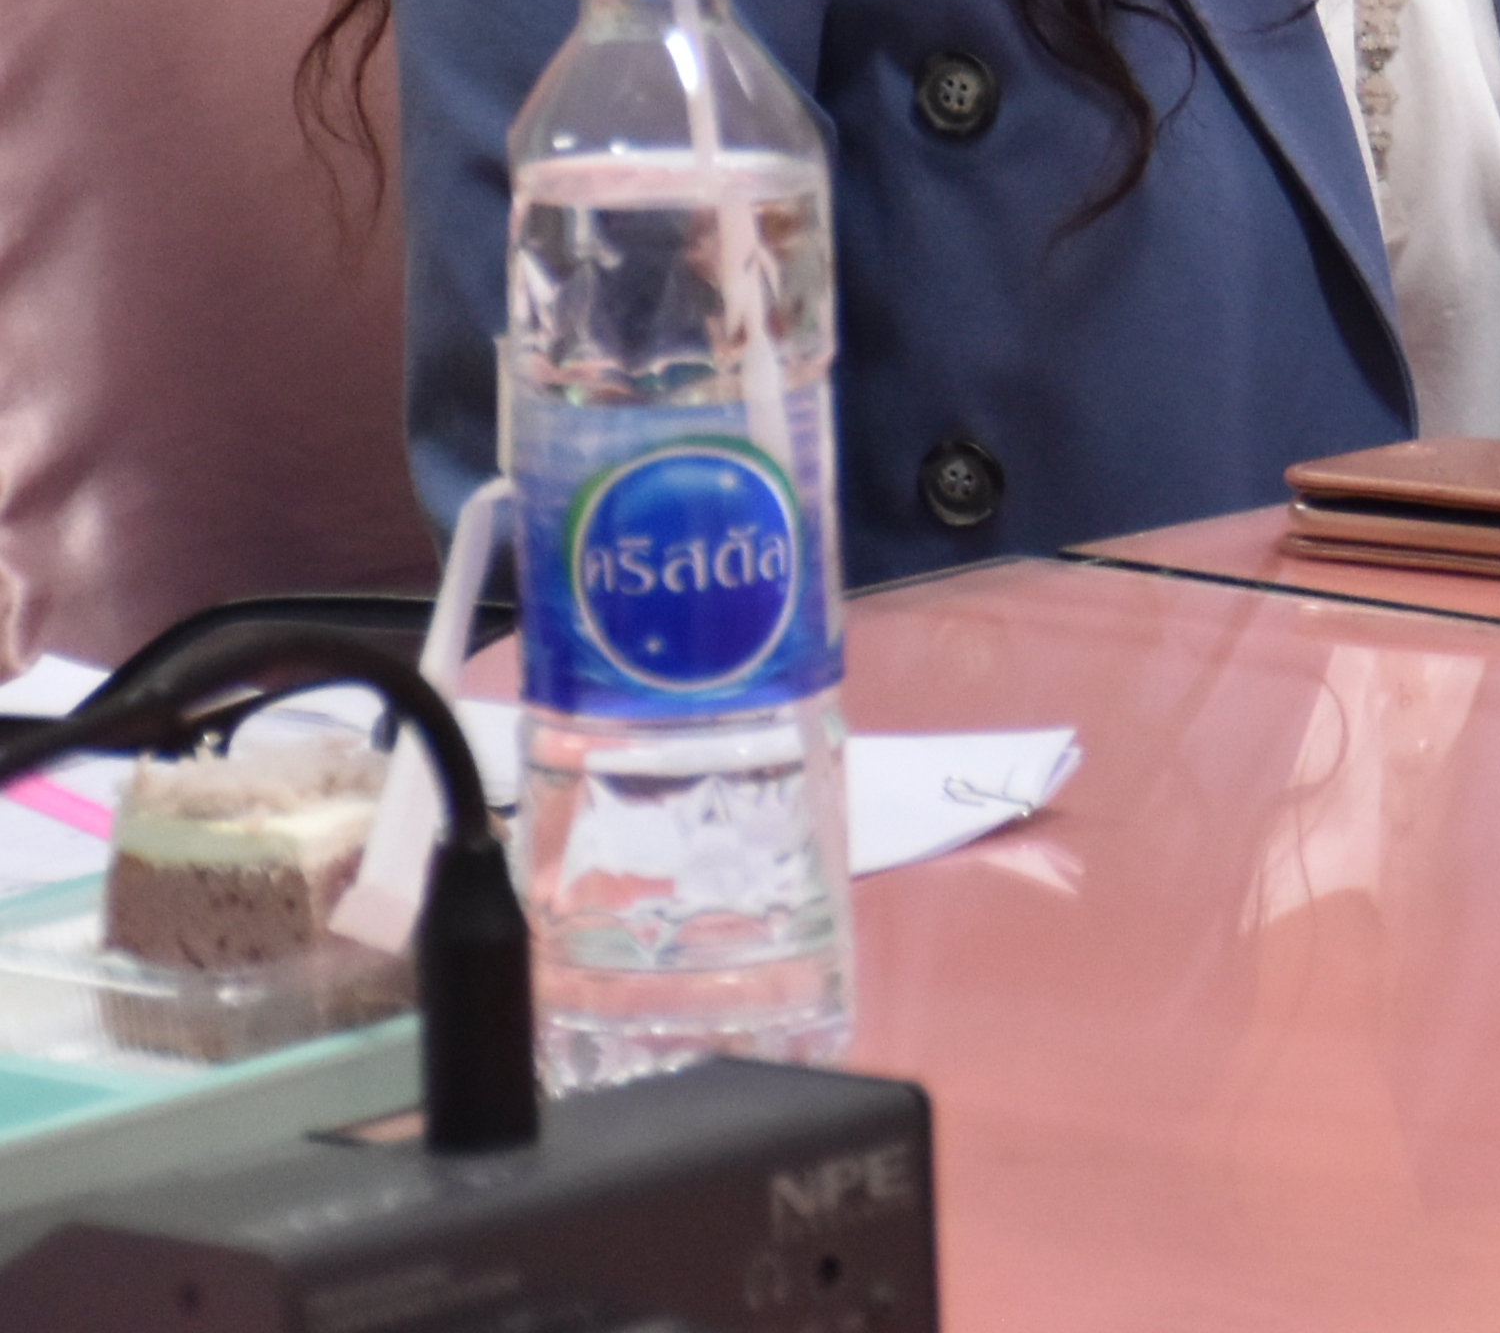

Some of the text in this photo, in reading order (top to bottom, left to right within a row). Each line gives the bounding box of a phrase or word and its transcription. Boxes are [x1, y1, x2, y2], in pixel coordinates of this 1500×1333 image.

[582, 525, 789, 597] คริสตัล
[770, 1139, 912, 1241] NPE
